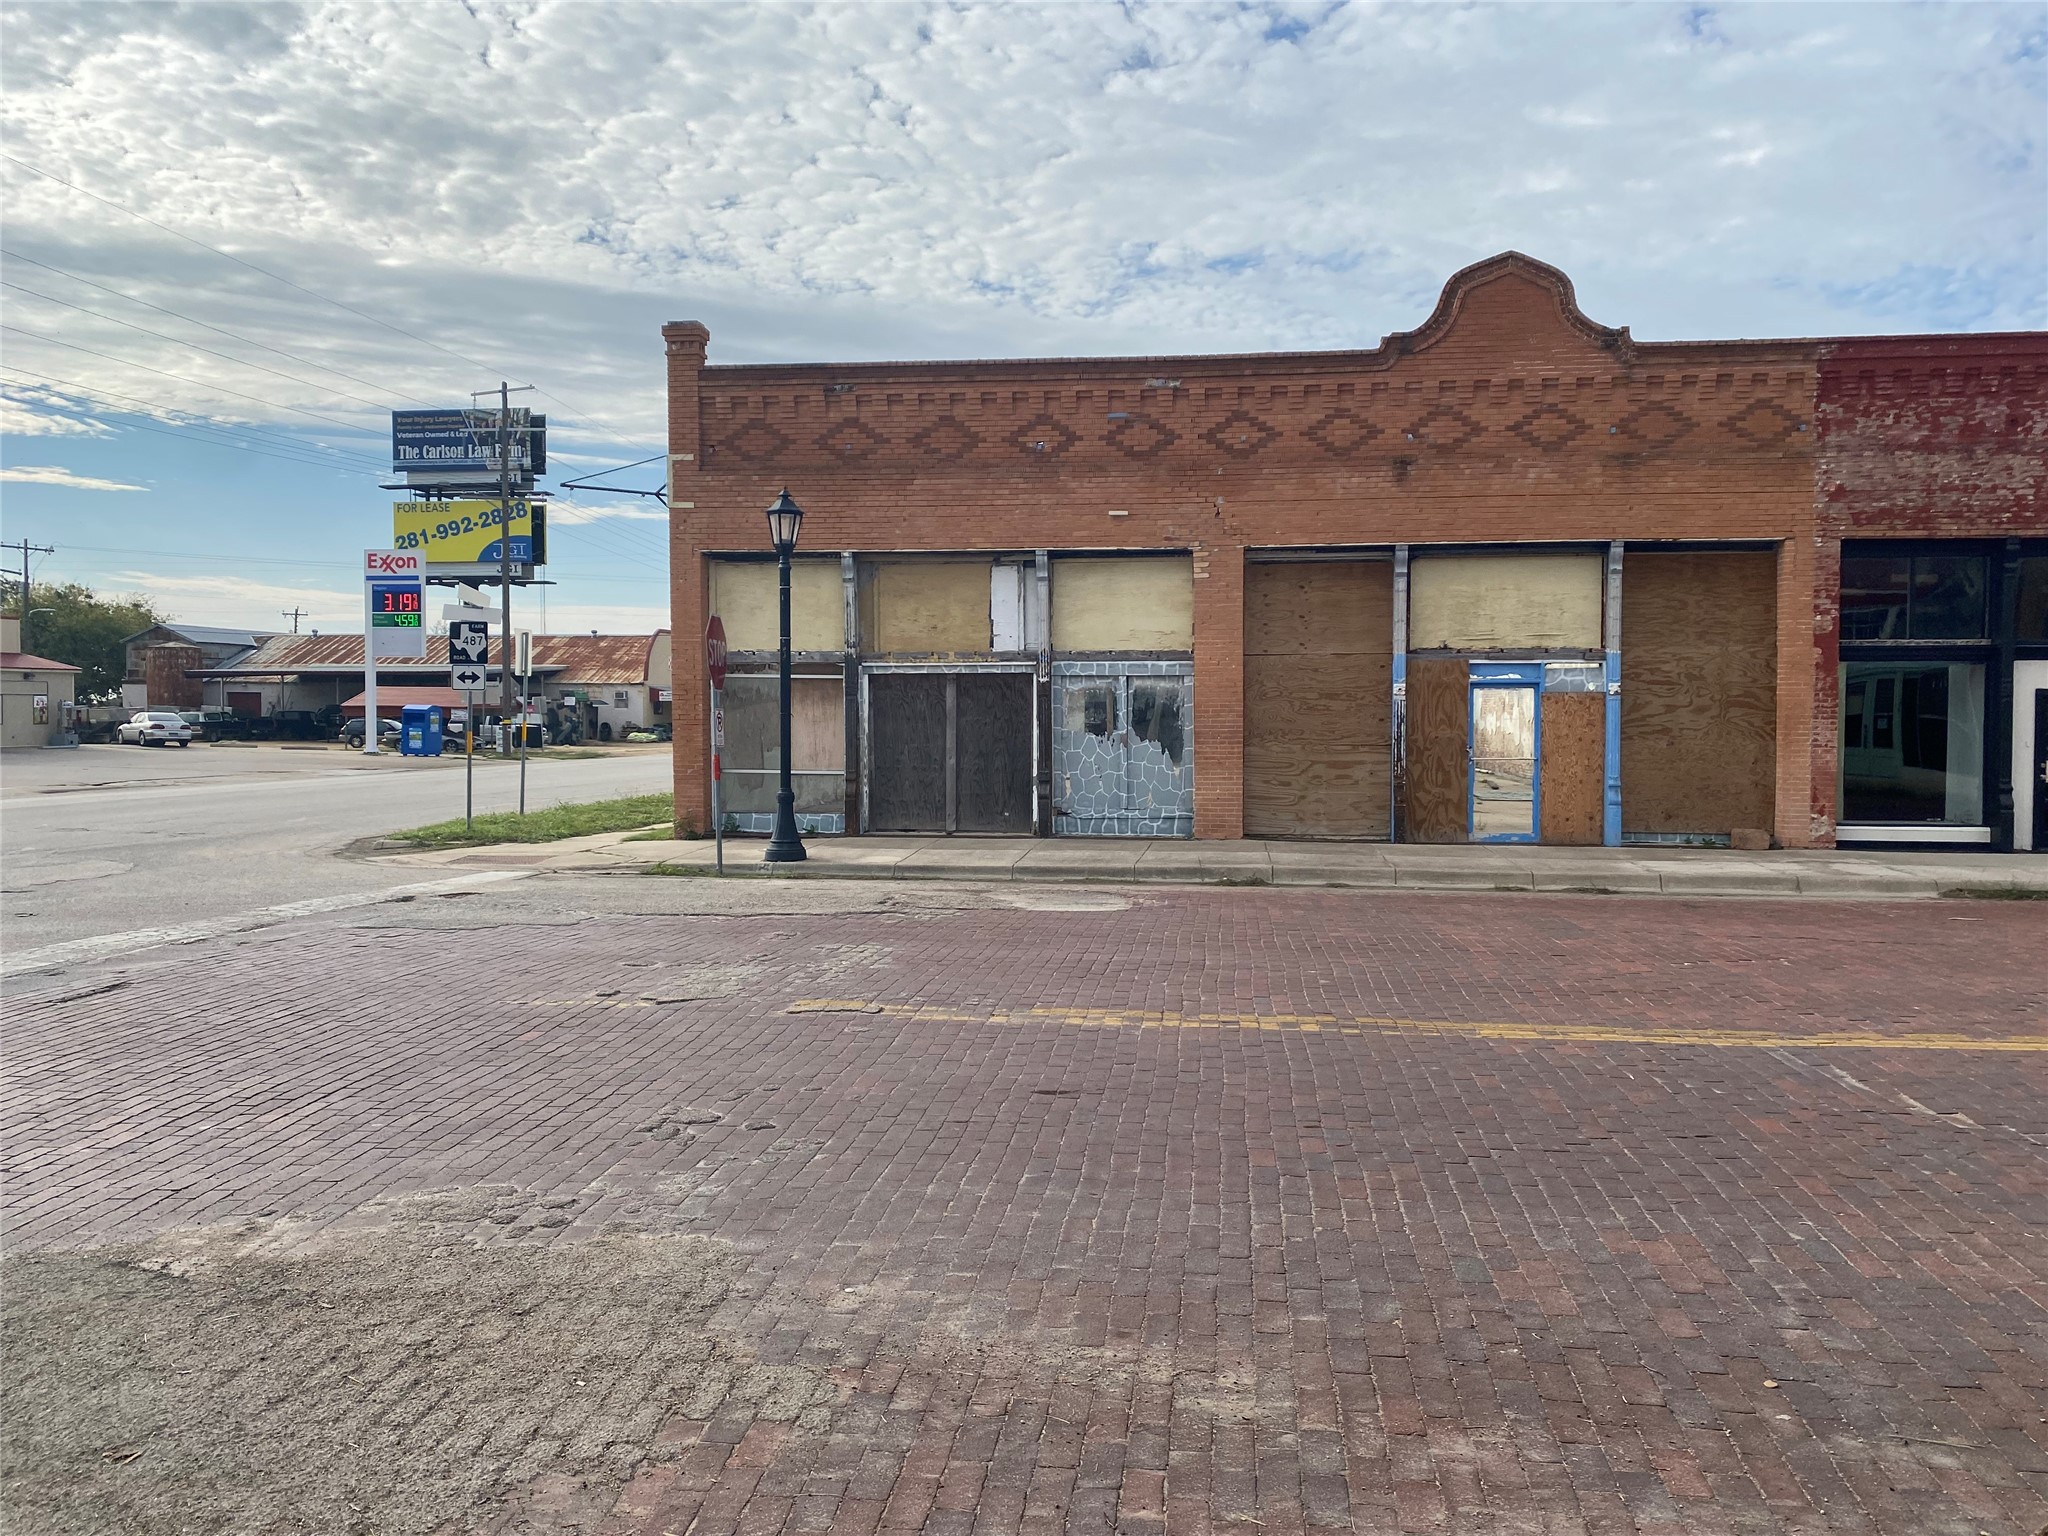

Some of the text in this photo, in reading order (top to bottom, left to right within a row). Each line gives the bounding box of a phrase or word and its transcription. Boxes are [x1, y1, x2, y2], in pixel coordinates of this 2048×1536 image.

[398, 446, 419, 459] The
[423, 444, 464, 459] Carlson
[468, 444, 491, 458] Law
[397, 503, 450, 513] FOR LEASE
[395, 502, 528, 549] 281-992-2828
[367, 553, 417, 574] Exxon
[462, 636, 483, 646] 487
[709, 639, 726, 667] STOP
